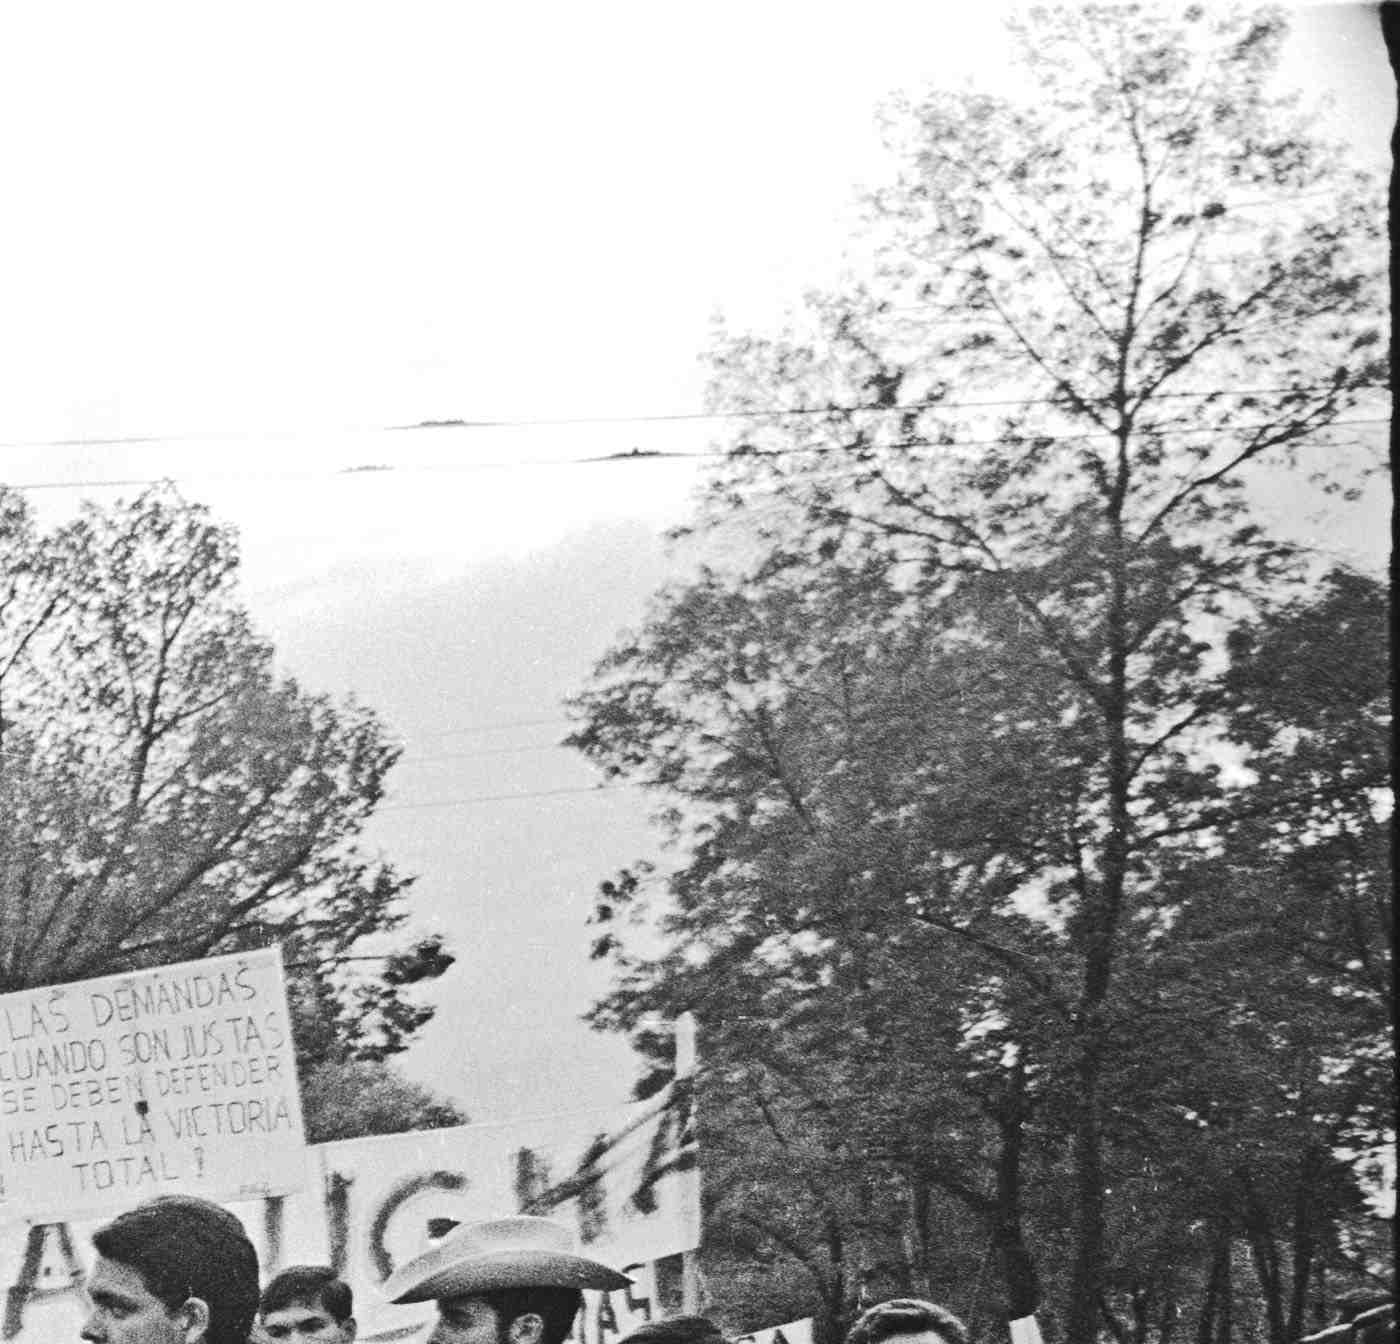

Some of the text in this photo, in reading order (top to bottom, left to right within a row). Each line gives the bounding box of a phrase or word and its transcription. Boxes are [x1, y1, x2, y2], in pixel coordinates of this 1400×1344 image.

[4, 966, 257, 1041] LAS DEMANDAS
[118, 1029, 172, 1066] SON
[180, 1010, 286, 1061] JUSTAS
[1, 1054, 283, 1115] SE DEBEN DEFENDER
[7, 1099, 294, 1163] HASTA LA VICTORIA
